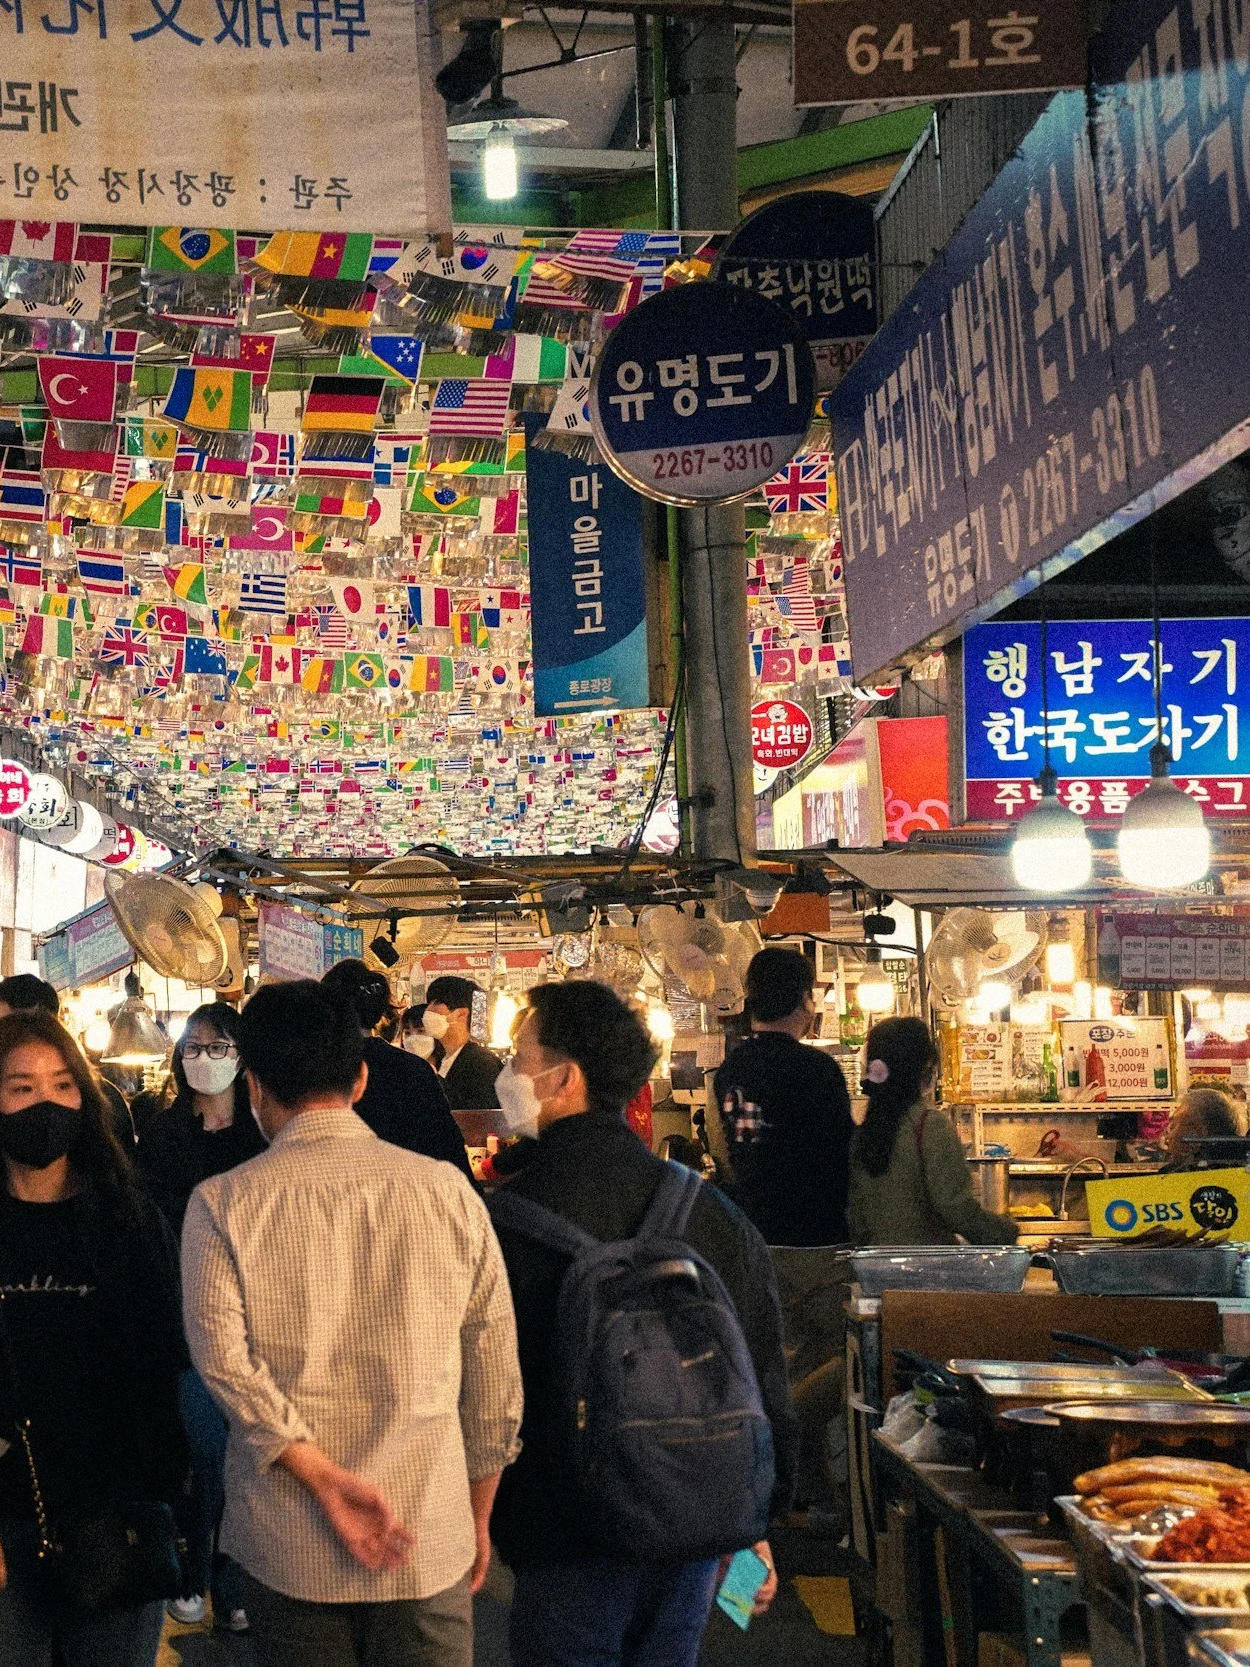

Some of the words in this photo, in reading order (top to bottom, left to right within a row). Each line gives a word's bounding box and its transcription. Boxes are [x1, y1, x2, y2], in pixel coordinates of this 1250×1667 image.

[846, 11, 1041, 76] 64-1호
[609, 344, 799, 422] 유명도기
[654, 442, 773, 479] 2267-3310
[925, 504, 991, 618] 유명도기
[1023, 364, 1161, 546] 2267-3310
[569, 677, 612, 694] 종로광장
[982, 703, 1239, 763] 한국도자기
[1109, 1063, 1145, 1073] 3,000원
[1114, 1047, 1149, 1059] 5,000원
[1108, 1078, 1148, 1088] 12,000원
[1142, 1201, 1184, 1224] SBS
